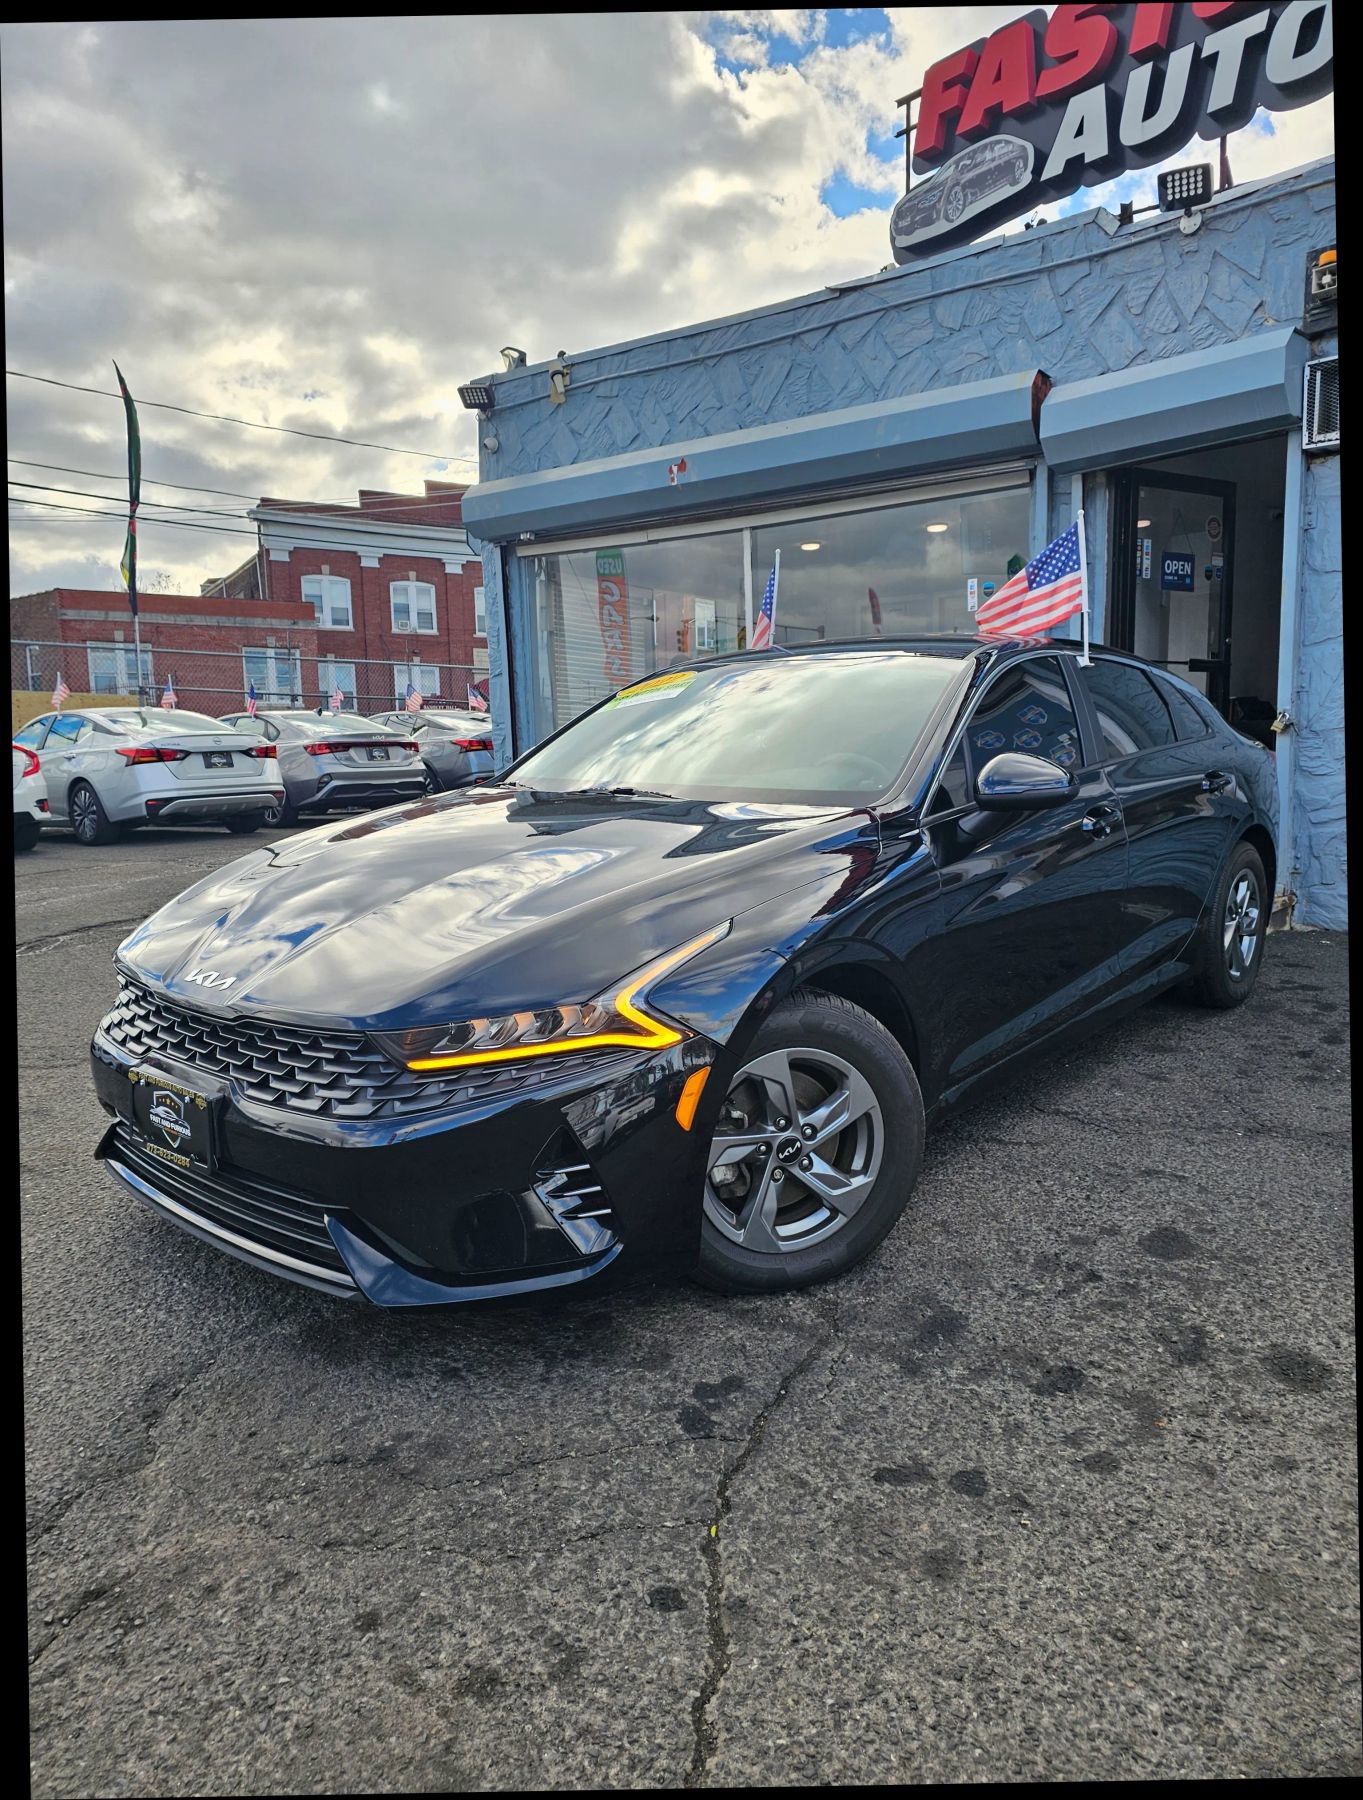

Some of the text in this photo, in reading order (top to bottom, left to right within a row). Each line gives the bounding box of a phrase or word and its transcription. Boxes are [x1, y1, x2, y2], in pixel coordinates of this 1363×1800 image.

[1164, 559, 1192, 575] OPEN
[184, 968, 238, 991] KIA
[149, 1113, 161, 1124] FAST
[160, 1118, 171, 1128] AND
[170, 1122, 192, 1137] FURIOUS
[778, 1141, 801, 1160] KIA
